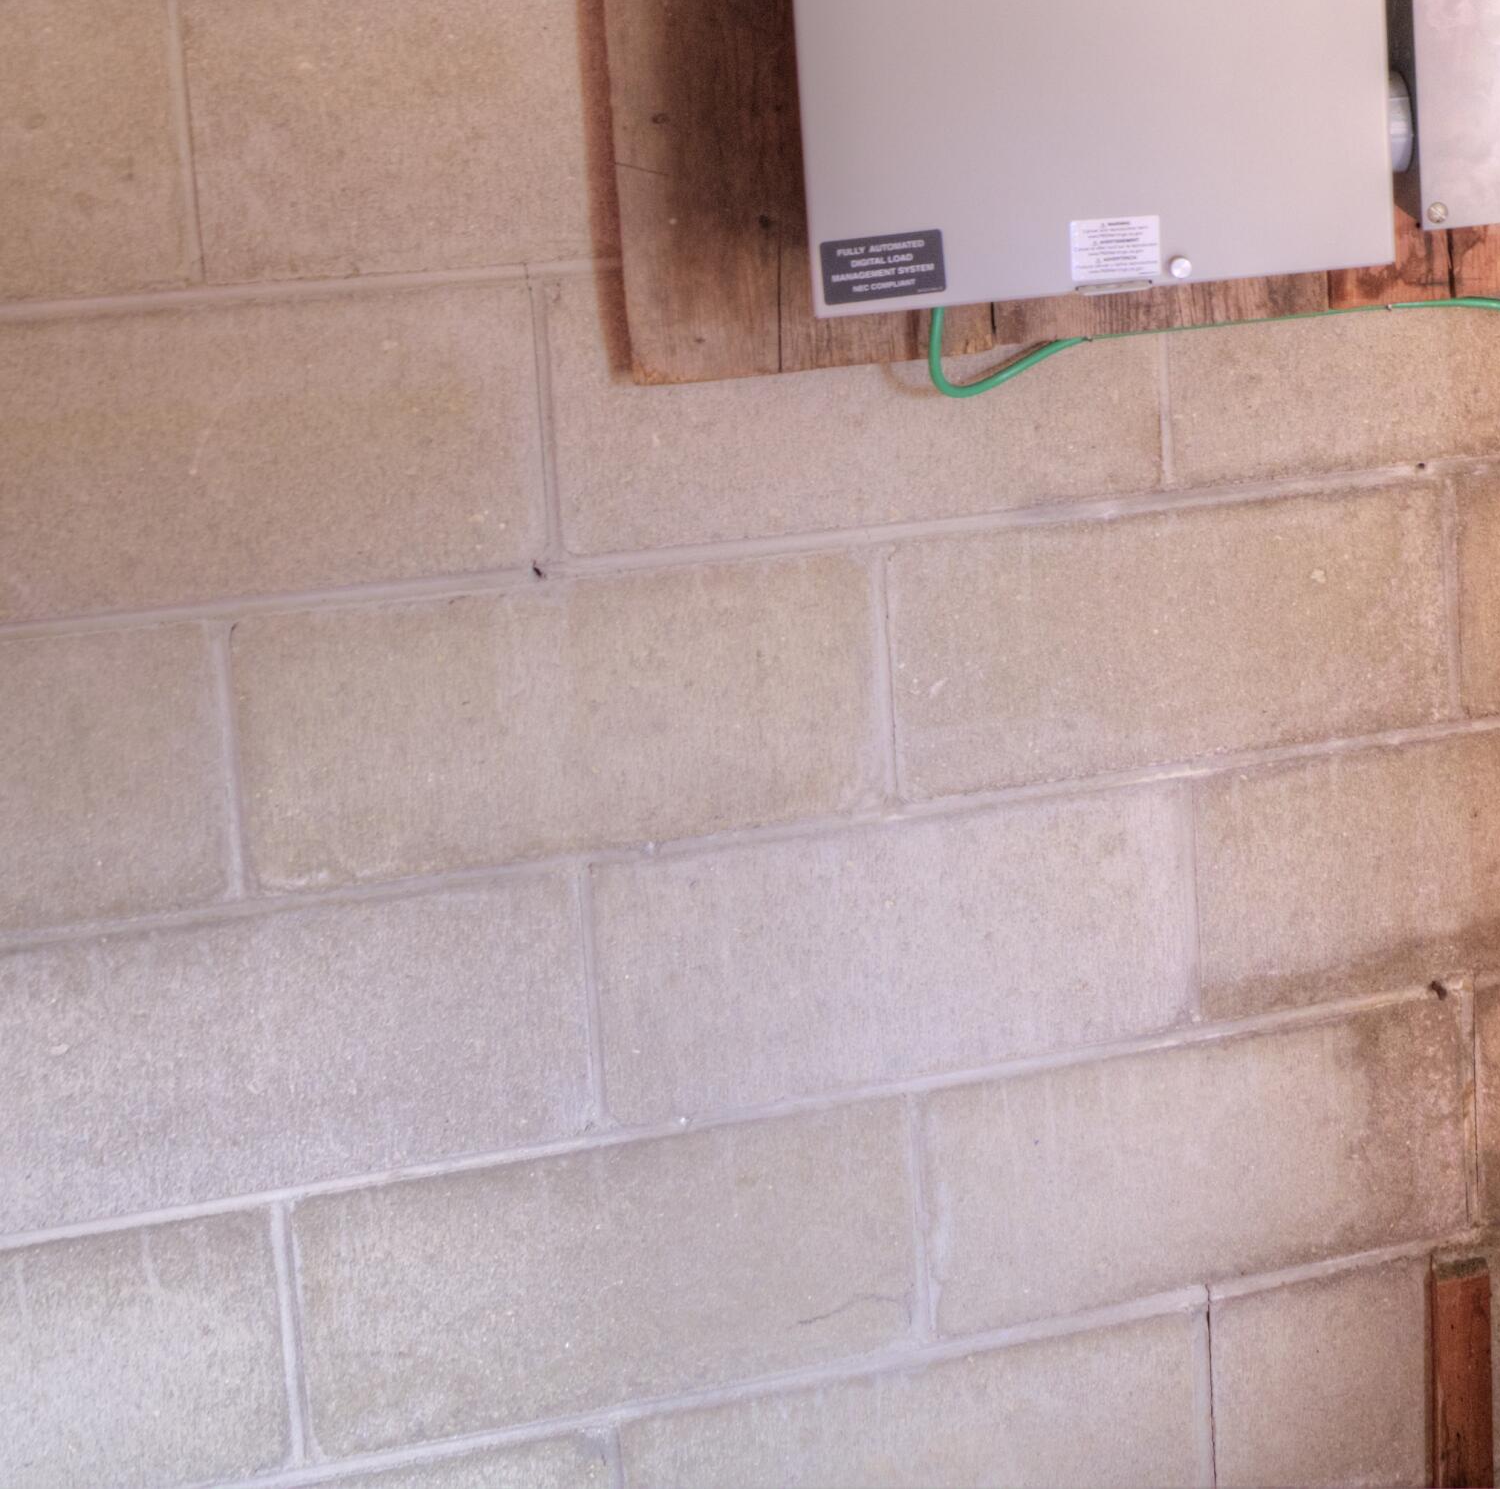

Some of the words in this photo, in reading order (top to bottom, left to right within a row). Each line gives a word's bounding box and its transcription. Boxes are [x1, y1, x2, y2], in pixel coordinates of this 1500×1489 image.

[836, 246, 866, 257] FULLY
[869, 240, 925, 253] AUTOMATED
[851, 257, 886, 268] DIGITAL
[888, 253, 914, 264] LOAD
[832, 268, 896, 283] MANAGEMENT
[897, 263, 935, 274] SYSTEM
[871, 279, 916, 291] COMPLIANT
